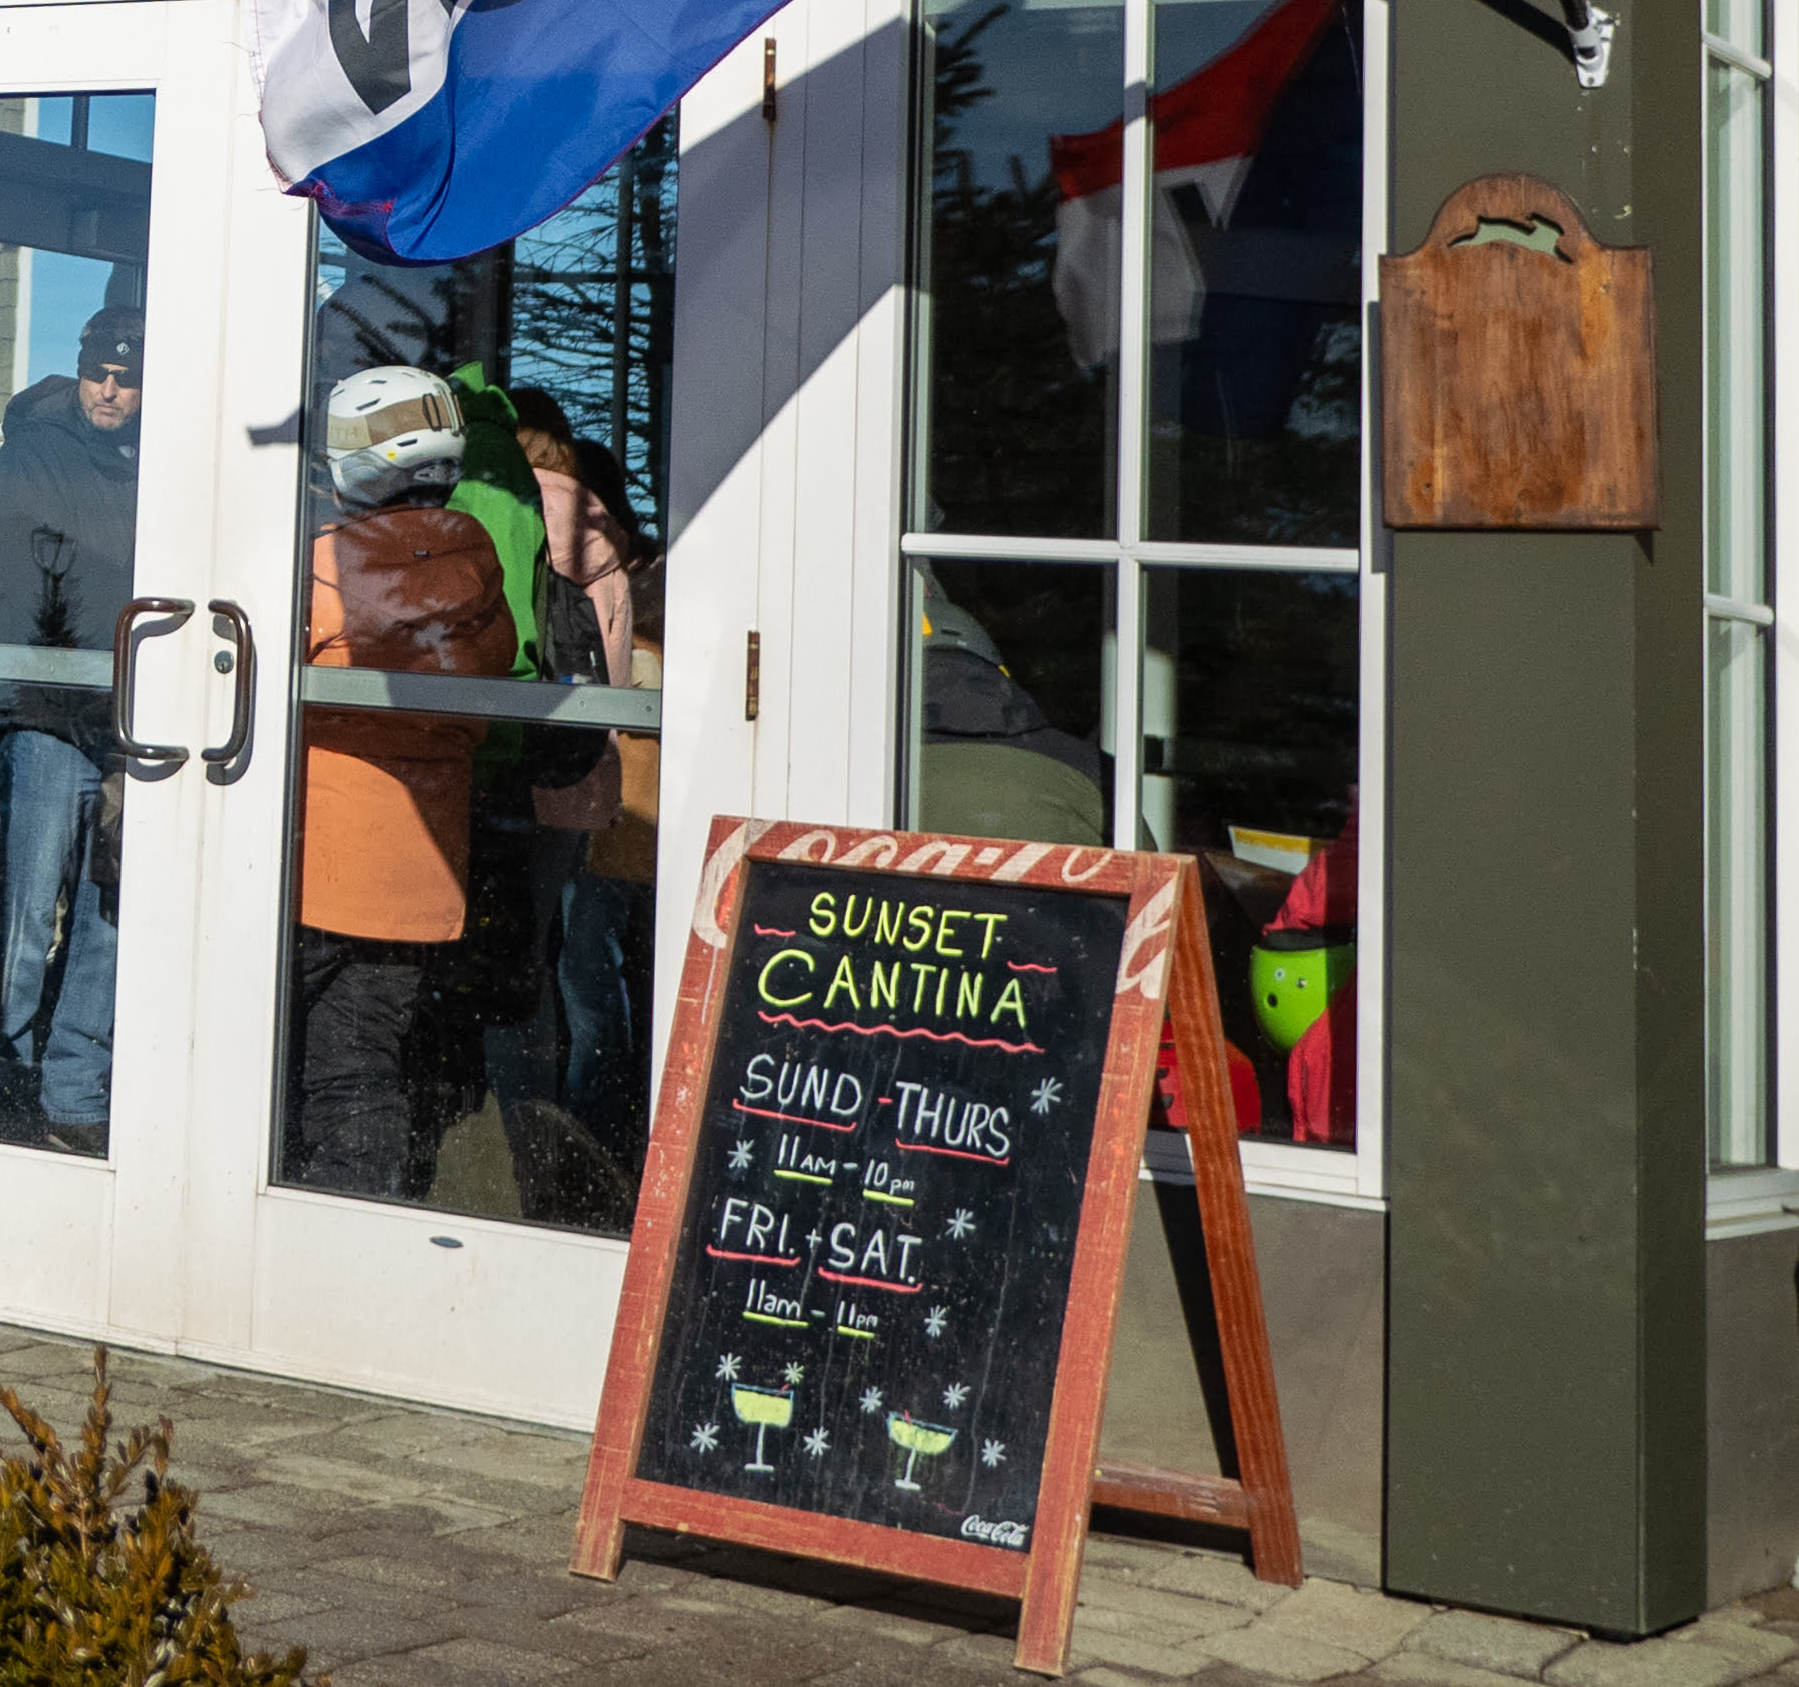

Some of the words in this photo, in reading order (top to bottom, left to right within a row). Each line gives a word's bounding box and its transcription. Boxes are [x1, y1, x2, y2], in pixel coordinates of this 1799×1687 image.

[808, 892, 1008, 960] SUNSET
[757, 948, 1027, 1027] CANTINA
[739, 1053, 863, 1115] SUND
